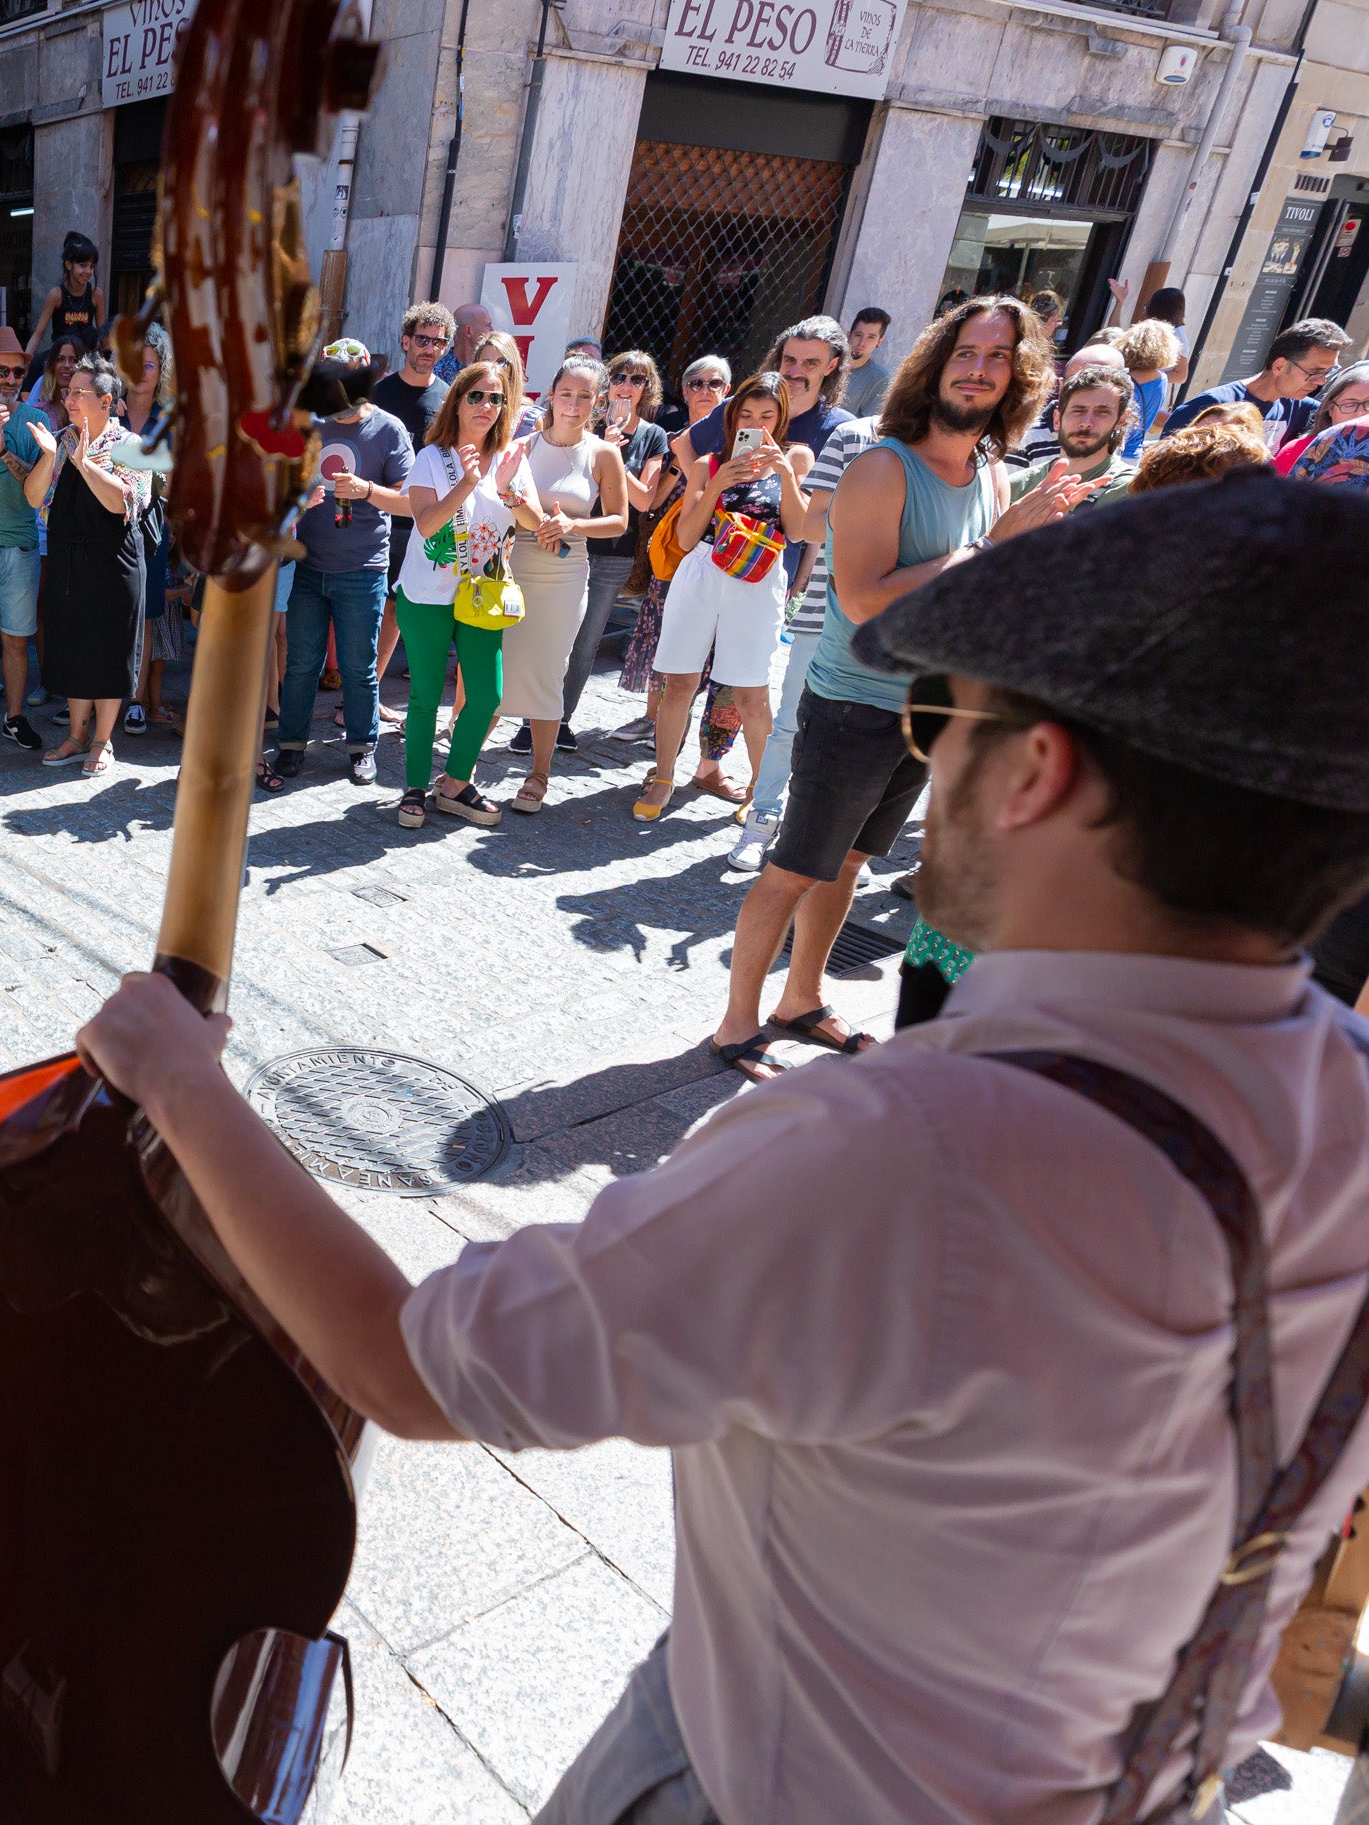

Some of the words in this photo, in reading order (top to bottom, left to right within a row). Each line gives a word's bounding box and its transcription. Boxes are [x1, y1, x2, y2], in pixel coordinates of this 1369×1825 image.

[674, 0, 718, 43] EL
[724, 0, 817, 55] PESO
[106, 33, 133, 78] EL
[686, 45, 711, 68] TEL.
[715, 51, 741, 71] 941
[742, 54, 760, 74] 22
[761, 58, 778, 77] 82
[779, 61, 796, 80] 54
[855, 41, 880, 57] TIERRA
[115, 81, 134, 100] TEL.
[137, 75, 154, 97] 941
[156, 72, 169, 90] 22
[1285, 206, 1315, 222] TIVOLI
